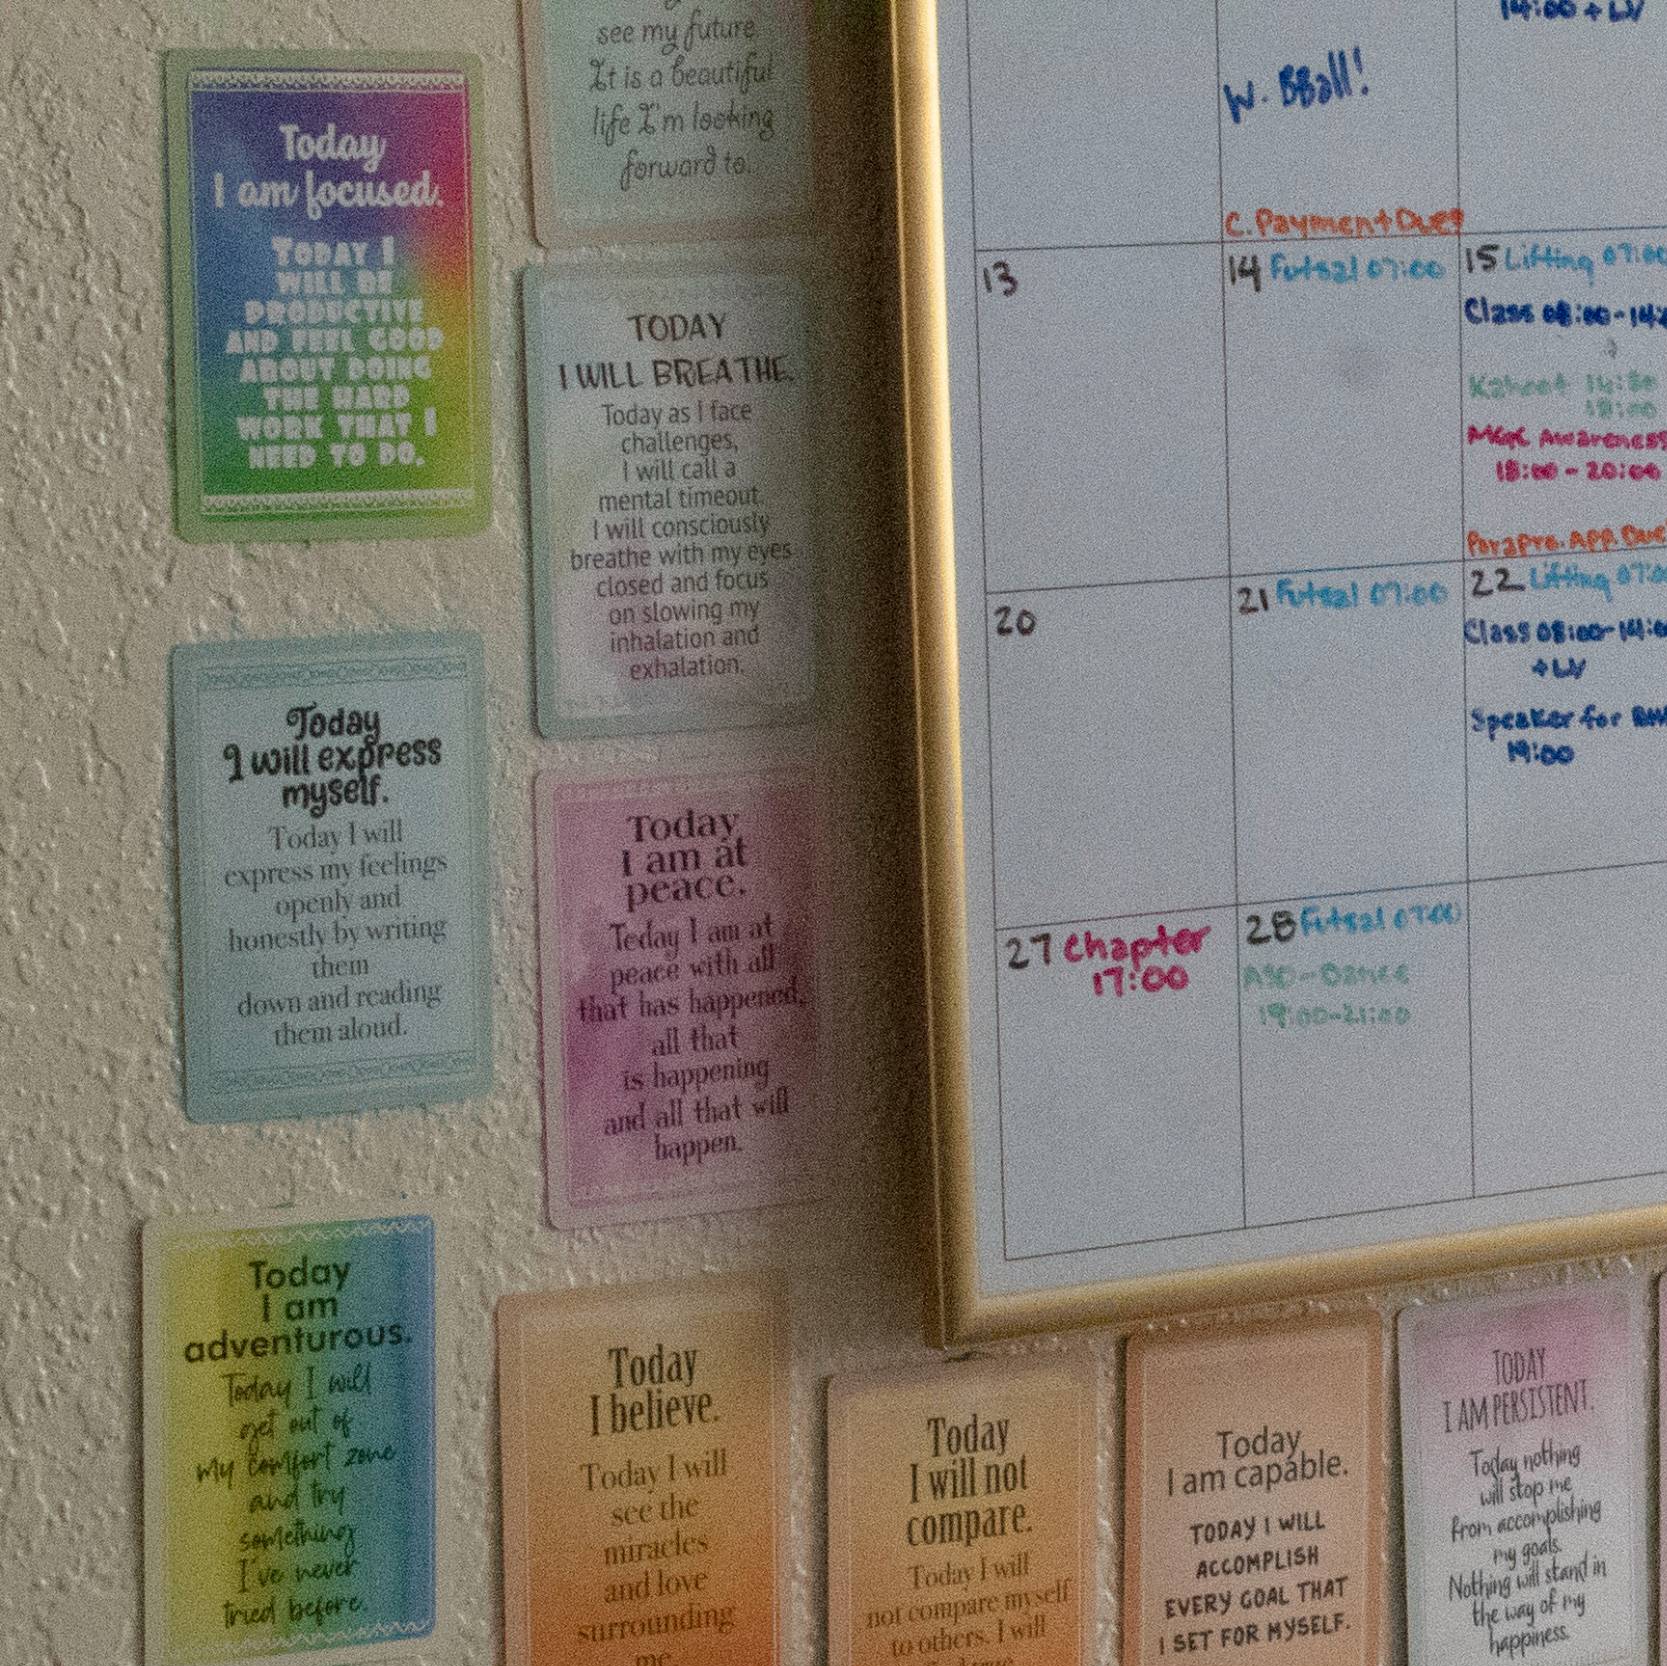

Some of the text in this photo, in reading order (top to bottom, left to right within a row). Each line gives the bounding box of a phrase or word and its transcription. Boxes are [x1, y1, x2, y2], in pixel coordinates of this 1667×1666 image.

[1279, 49, 1370, 106] BBall!
[280, 123, 386, 170] Today
[621, 145, 716, 191] forward
[214, 172, 444, 219] I am focused.
[983, 261, 1018, 296] 13
[1229, 255, 1261, 292] 14
[1270, 252, 1357, 284] Futsal
[1466, 244, 1499, 273] 15
[1504, 244, 1594, 287] Lifting
[628, 312, 727, 341] TODAY
[560, 355, 795, 391] I WILL BREATHE.
[621, 428, 739, 455] challenges,
[1237, 587, 1270, 616] 21
[1471, 568, 1525, 597] 22
[610, 624, 759, 653] inhalation and
[993, 606, 1036, 636] 20
[630, 653, 744, 681] exhalation.
[287, 703, 381, 745] Today
[223, 738, 441, 783] I will express
[282, 774, 389, 818] myself.
[628, 809, 739, 843] Today
[622, 838, 748, 876] I am at
[628, 873, 746, 912] peace.
[1006, 924, 1212, 970] 27 Chapter
[1245, 911, 1296, 945] 28
[1094, 966, 1189, 997] 17:00
[654, 1135, 742, 1167] happen.
[250, 1257, 351, 1294] Today
[262, 1297, 338, 1321] I am
[184, 1321, 412, 1363] adventurous.
[609, 1345, 698, 1391] Today
[1493, 1348, 1547, 1386] TODAY
[591, 1391, 719, 1436] I believe.
[1443, 1378, 1594, 1433] I AM PERSISTENT.
[927, 1413, 1010, 1457] Today
[1217, 1429, 1302, 1461] Today
[910, 1455, 1028, 1502] I will not
[1167, 1450, 1348, 1496] I am capable.
[907, 1505, 1032, 1547] compare.
[604, 1528, 709, 1565] miracles
[1196, 1545, 1318, 1579] ACCOMPLISH
[1165, 1576, 1348, 1620] EVERY GOAL THAT
[578, 1603, 735, 1641] surrounding
